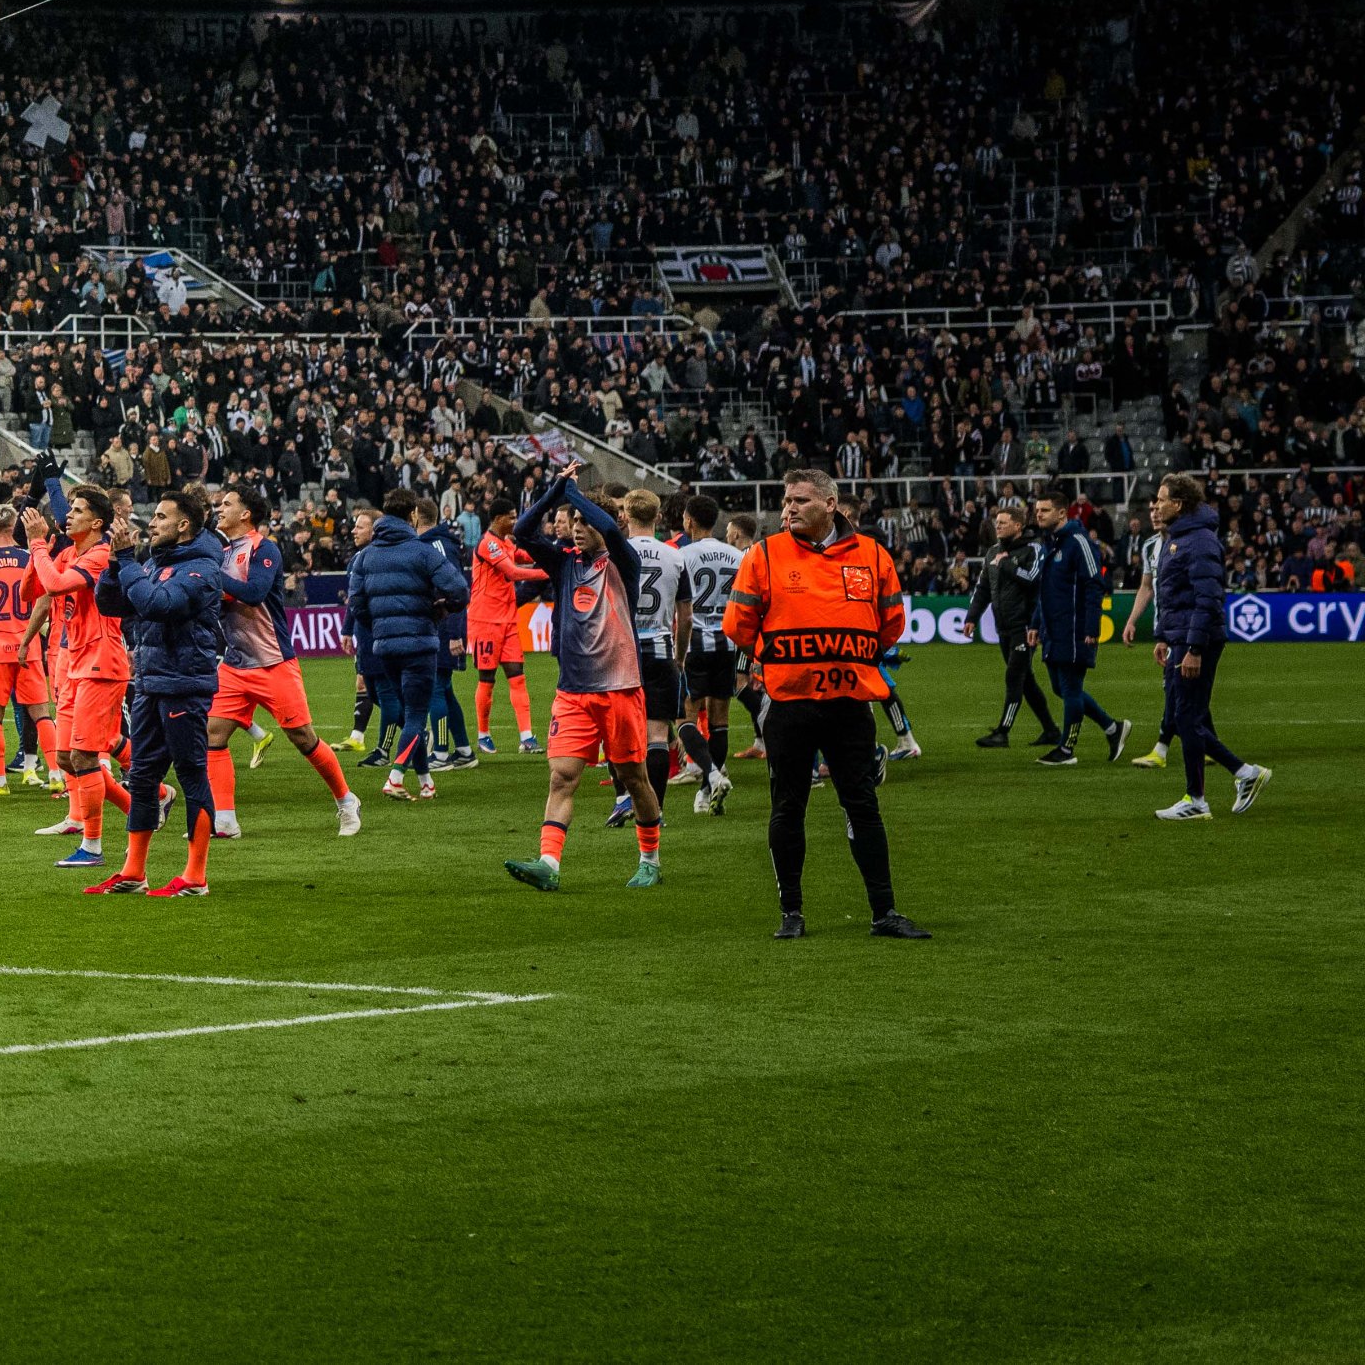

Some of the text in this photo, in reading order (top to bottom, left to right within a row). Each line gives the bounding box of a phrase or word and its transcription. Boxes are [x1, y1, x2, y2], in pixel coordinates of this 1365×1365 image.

[699, 552, 736, 565] MURPHY
[637, 567, 662, 615] 3
[479, 641, 494, 655] 14
[773, 634, 878, 659] STEWARD
[812, 667, 859, 693] 299
